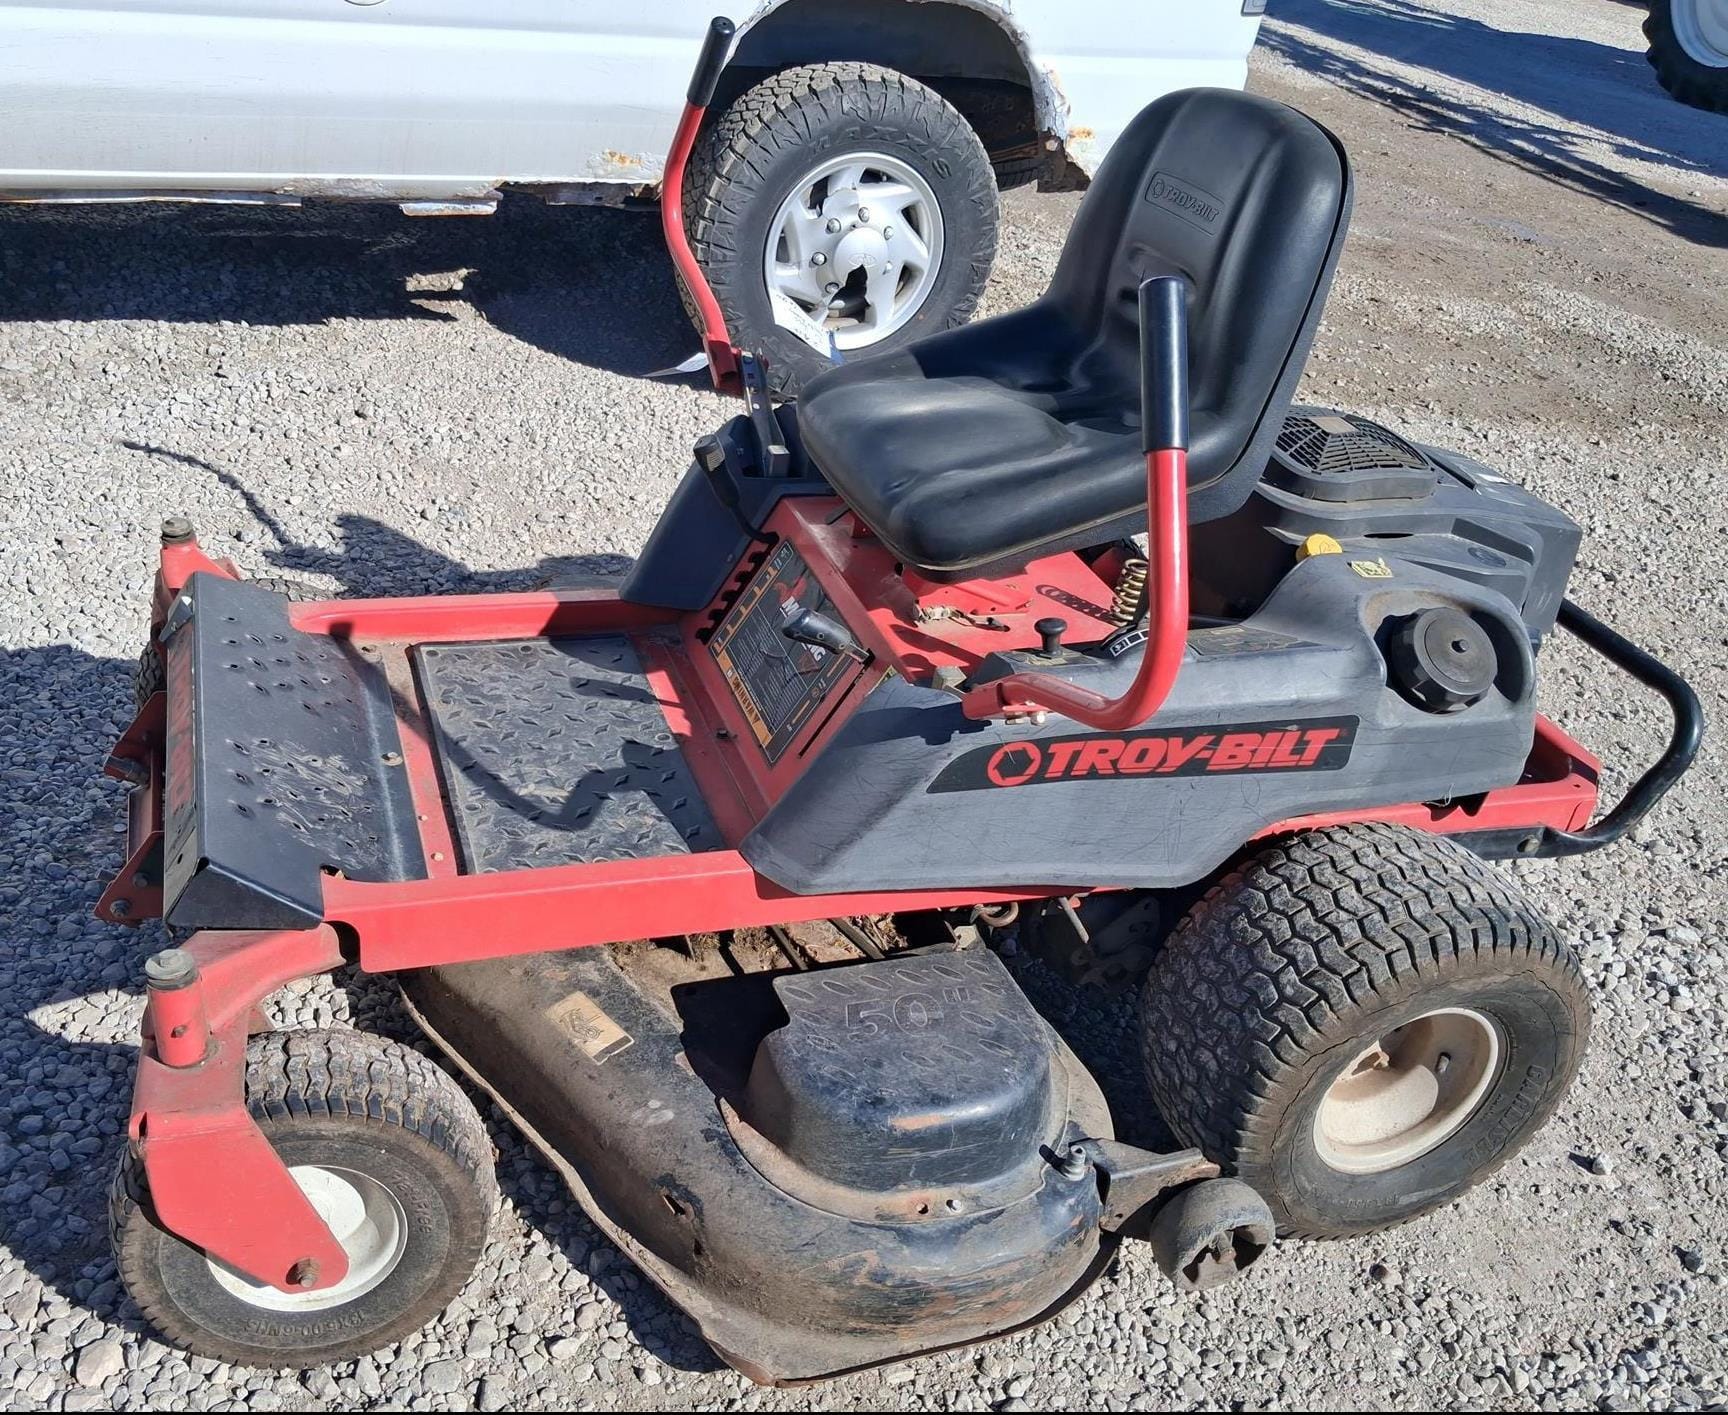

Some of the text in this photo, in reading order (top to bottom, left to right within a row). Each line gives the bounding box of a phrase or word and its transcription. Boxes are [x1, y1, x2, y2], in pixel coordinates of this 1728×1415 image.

[1163, 184, 1220, 222] TROY-BILT
[731, 675, 756, 717] WARNING
[1044, 727, 1341, 778] TROY-BILT
